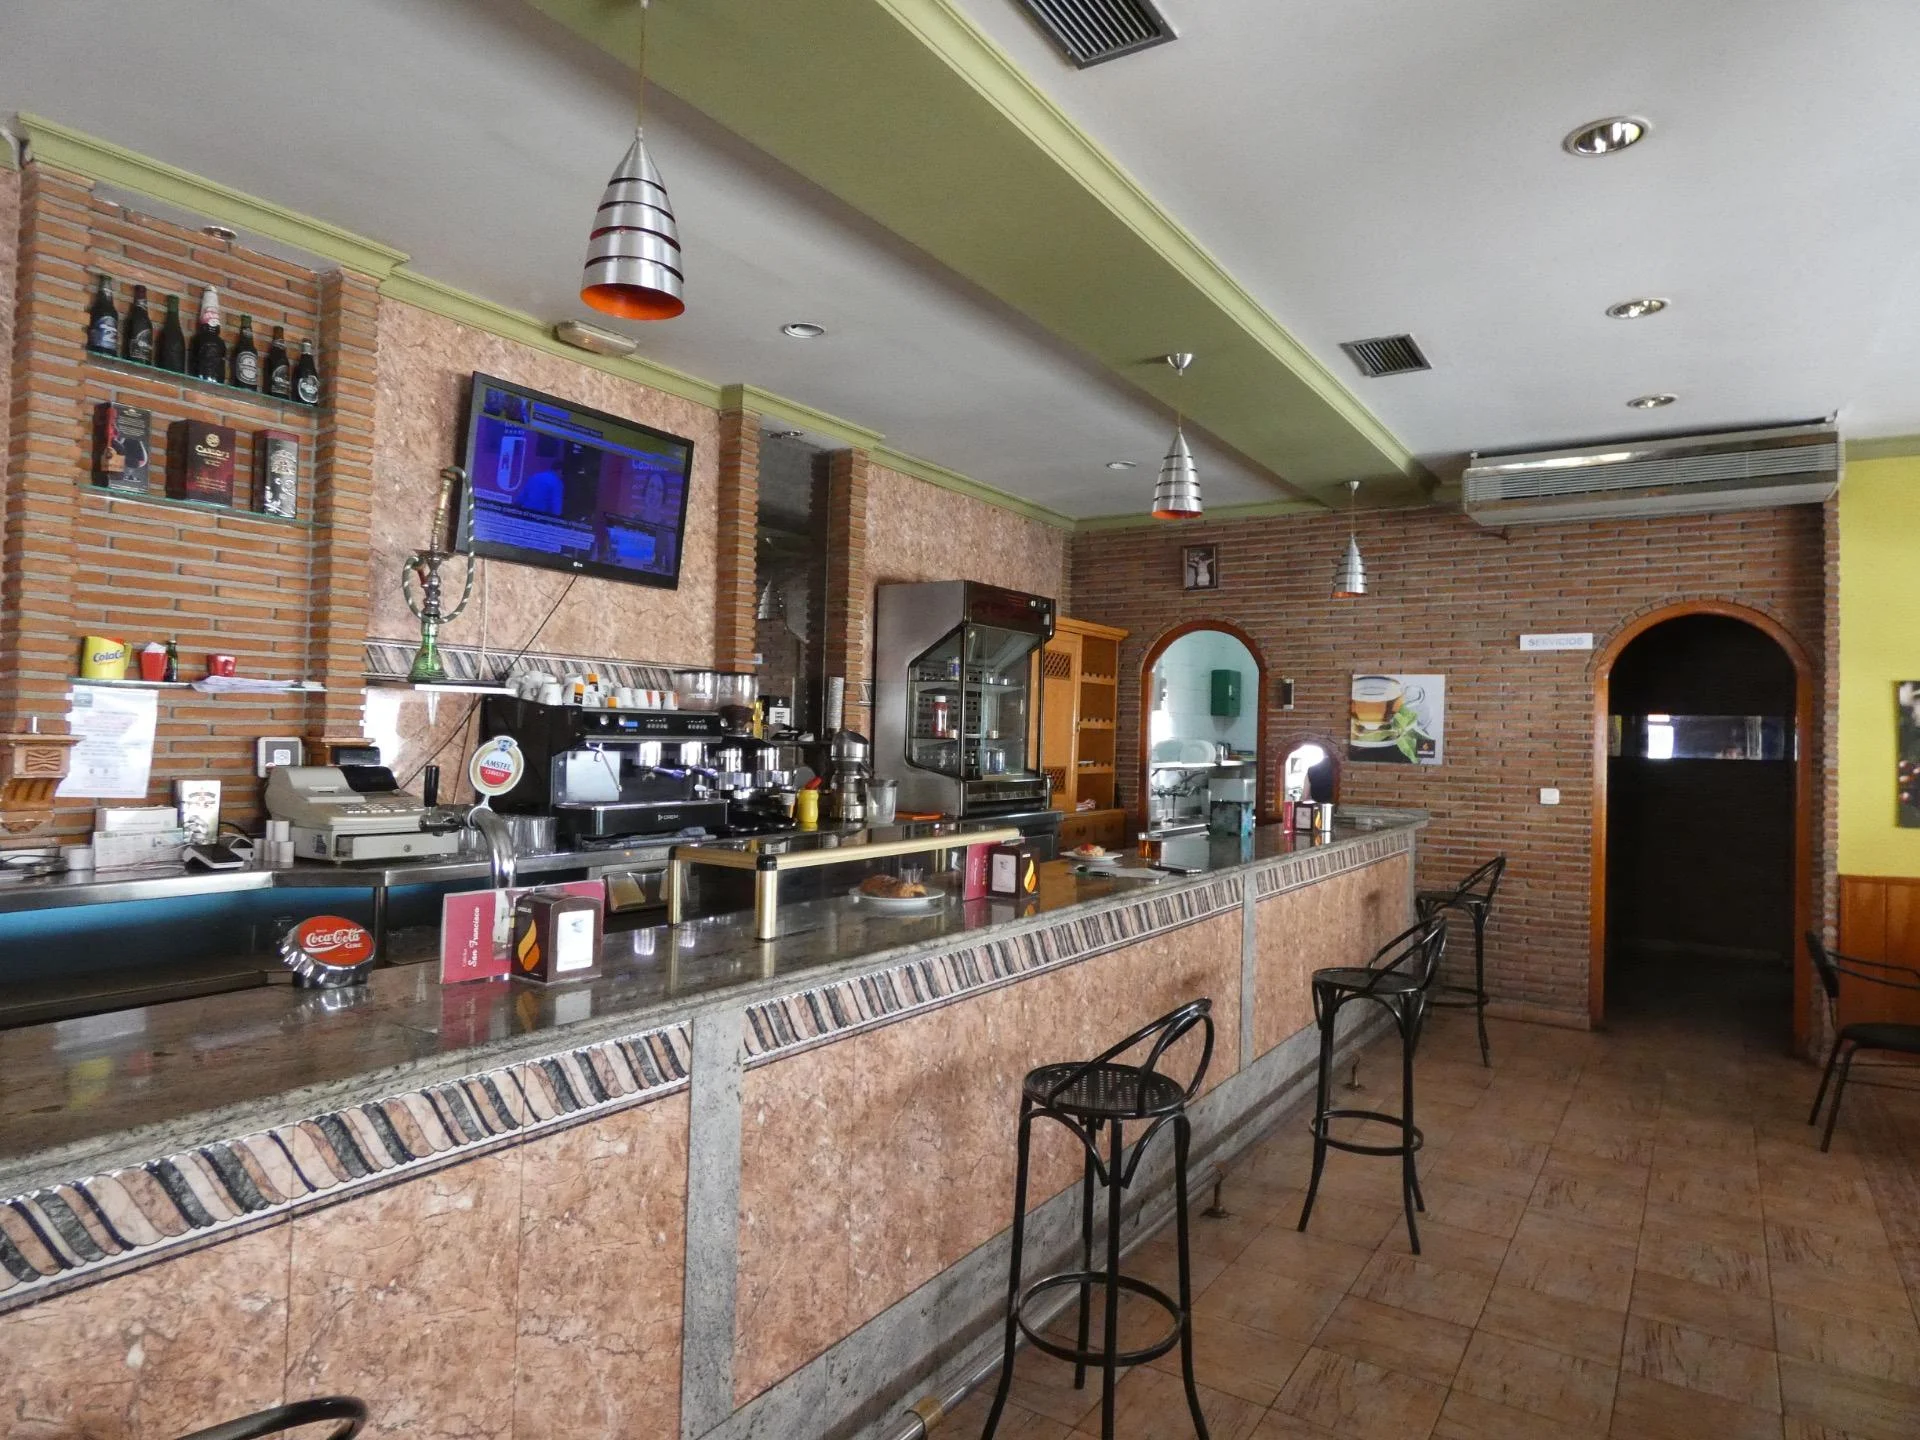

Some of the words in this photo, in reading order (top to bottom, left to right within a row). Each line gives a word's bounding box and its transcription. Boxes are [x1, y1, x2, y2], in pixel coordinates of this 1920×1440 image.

[1527, 637, 1585, 648] SERVICIOS
[484, 759, 511, 771] AMSTEL
[468, 906, 480, 948] Francisco
[305, 928, 365, 948] Coca-Cola
[467, 949, 478, 968] San
